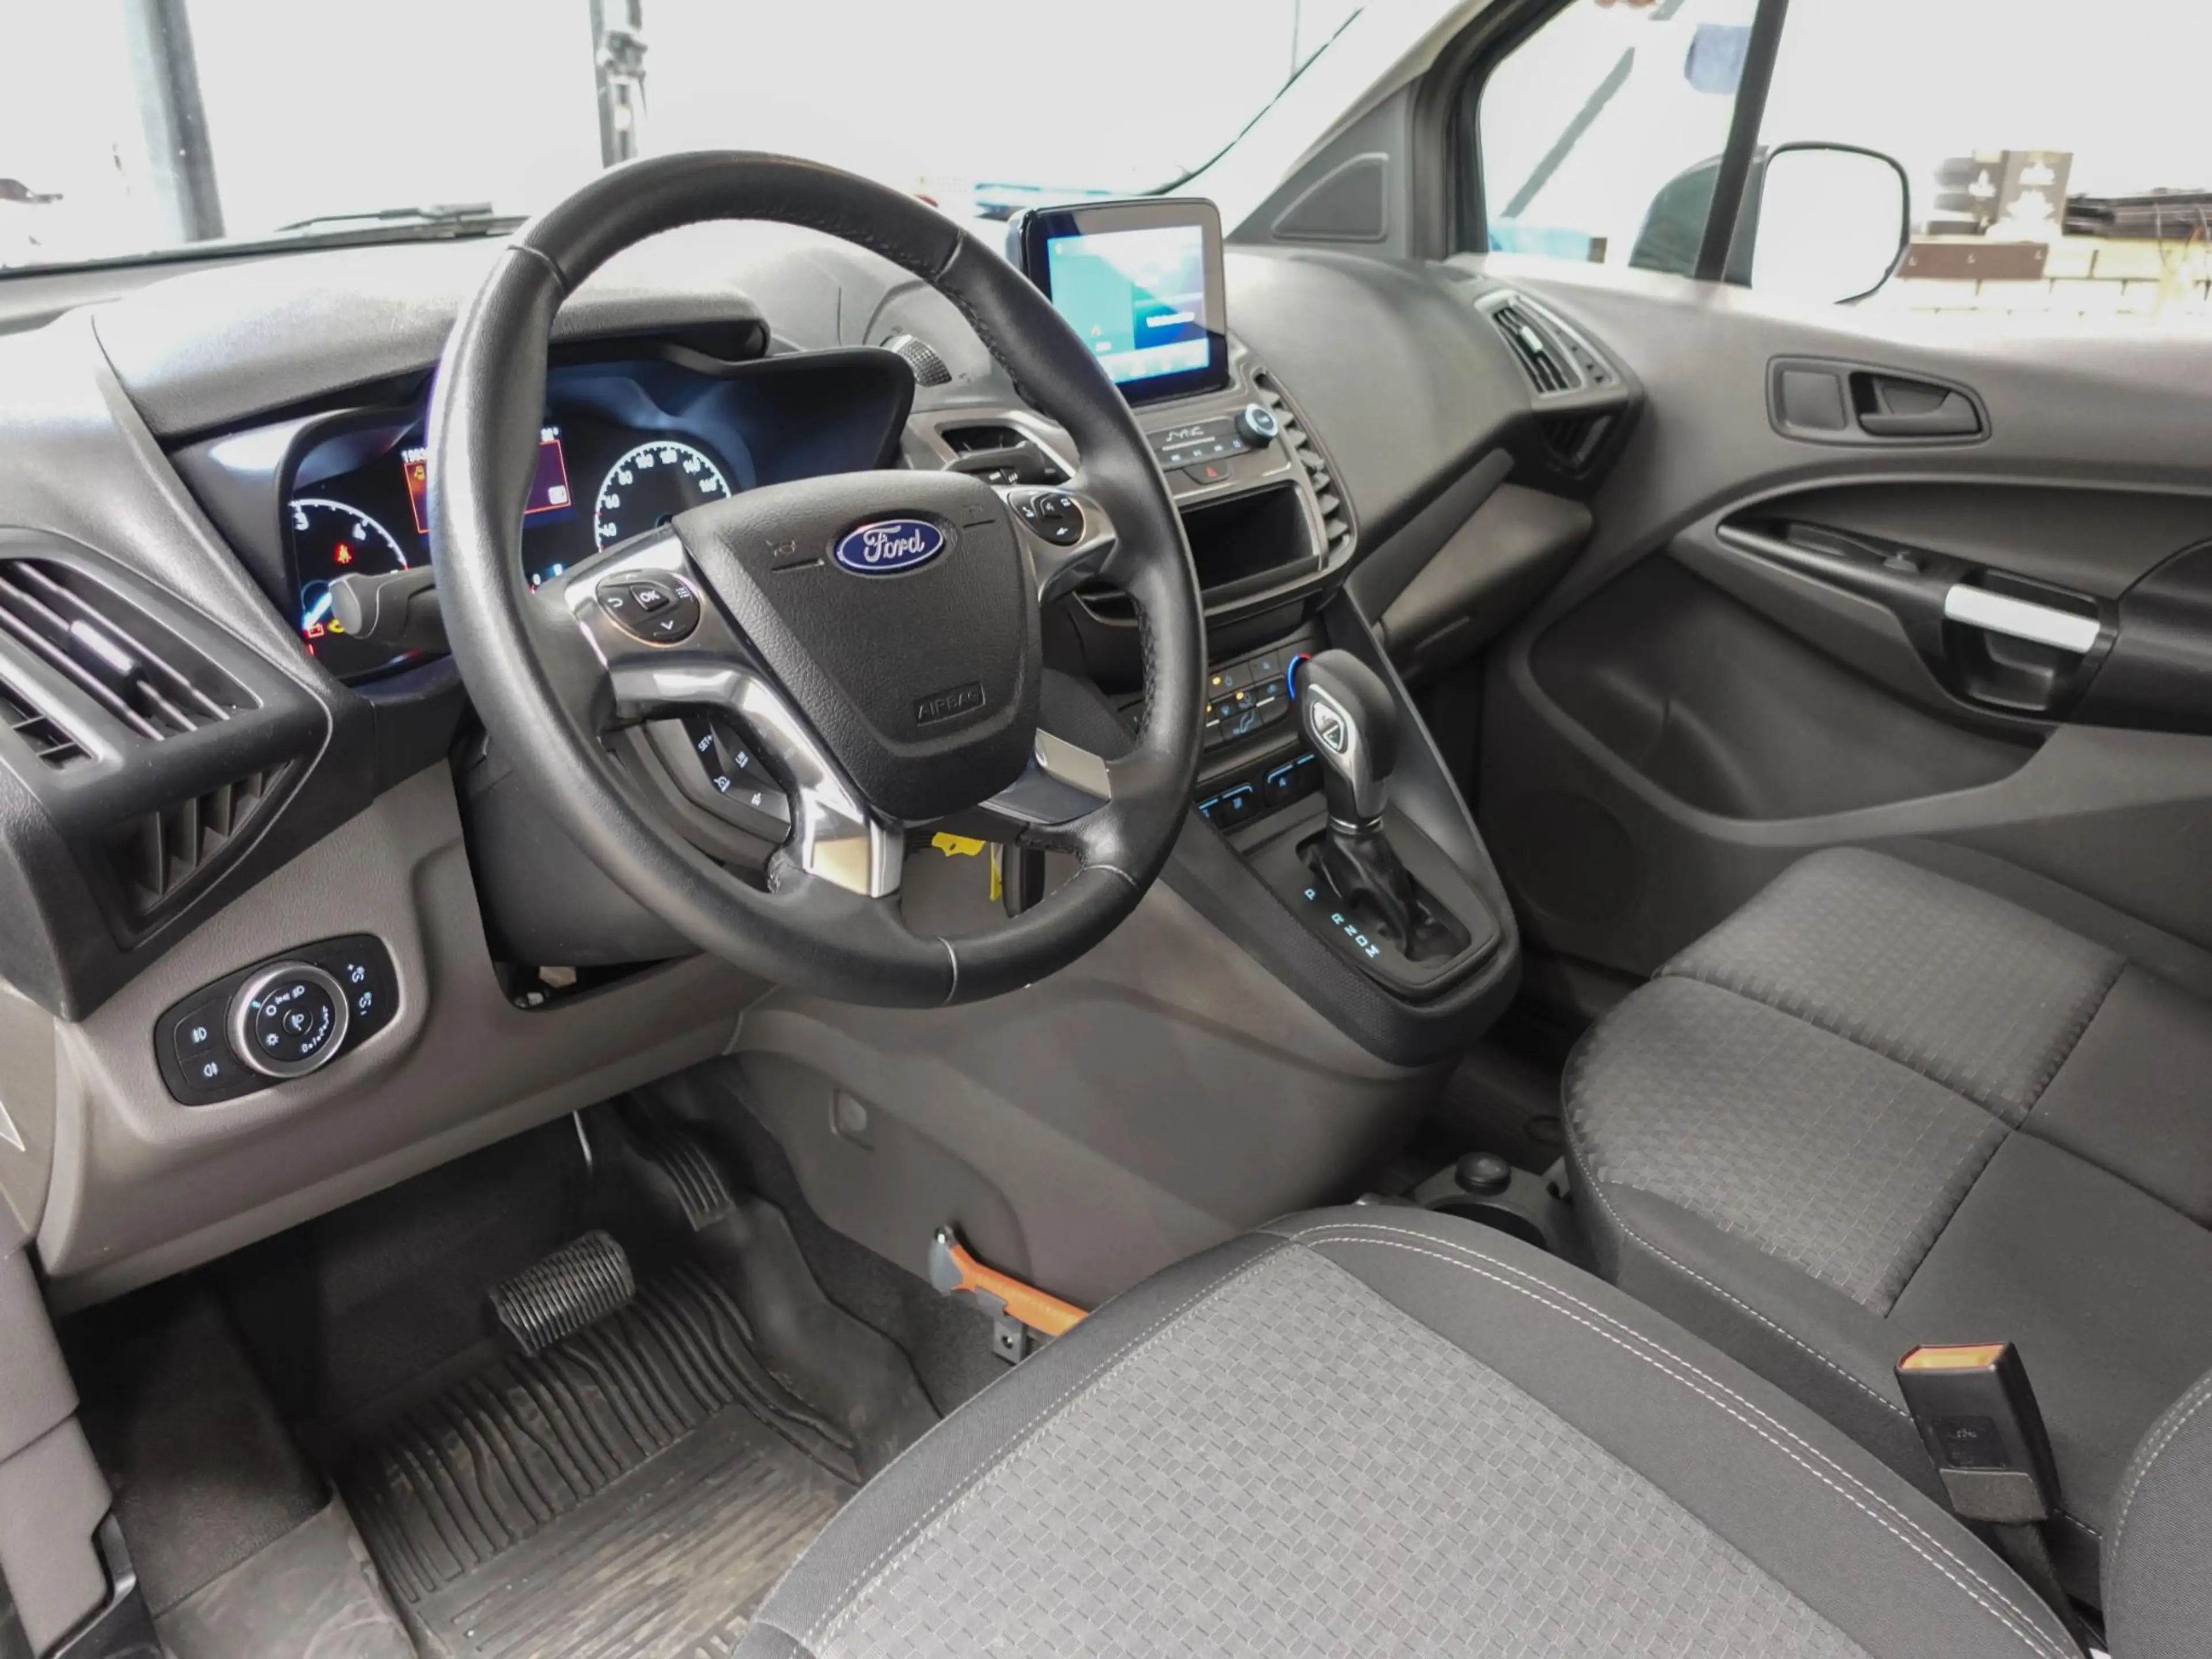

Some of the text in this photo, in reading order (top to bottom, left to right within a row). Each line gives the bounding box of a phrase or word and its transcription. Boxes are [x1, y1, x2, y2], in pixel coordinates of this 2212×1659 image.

[863, 525, 925, 563] Ford
[640, 589, 661, 603] OK
[1305, 888, 1316, 900] P
[1331, 913, 1344, 925] R
[1344, 925, 1358, 937] N
[1355, 934, 1368, 947] D
